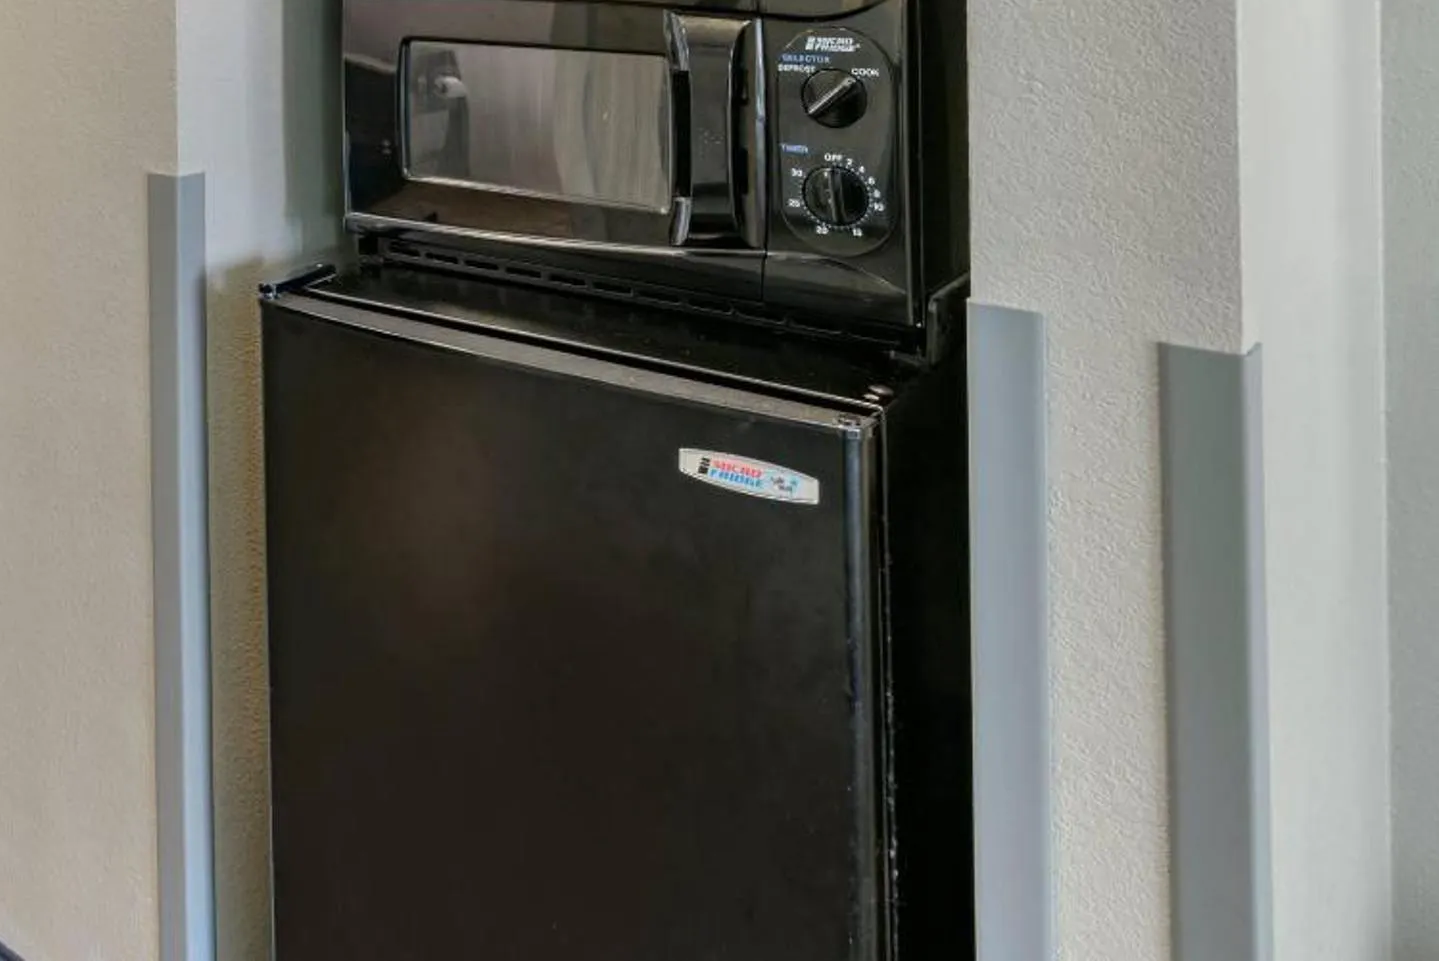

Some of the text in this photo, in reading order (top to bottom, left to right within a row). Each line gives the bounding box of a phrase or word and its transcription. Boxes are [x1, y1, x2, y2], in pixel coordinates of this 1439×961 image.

[781, 53, 831, 64] SELECTOR
[777, 63, 816, 74] DEFROST
[851, 67, 880, 77] COOK
[824, 152, 843, 162] OFF
